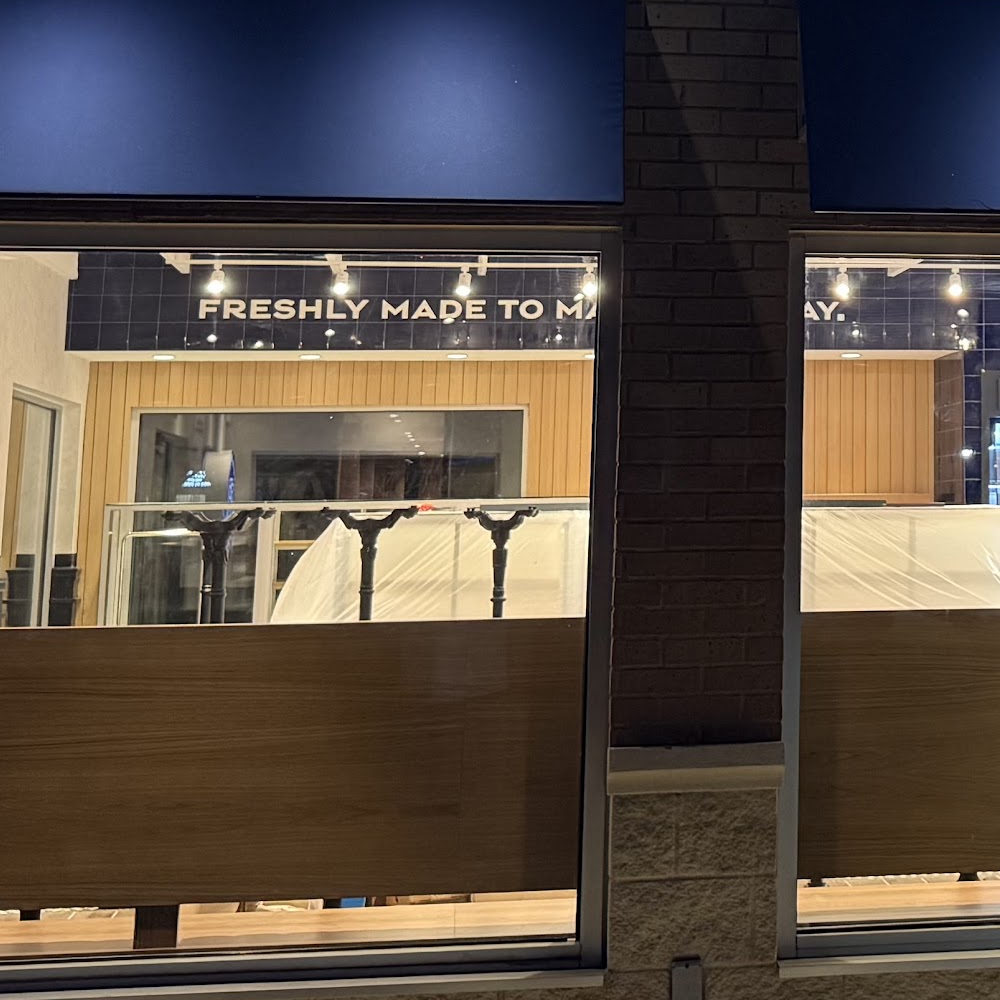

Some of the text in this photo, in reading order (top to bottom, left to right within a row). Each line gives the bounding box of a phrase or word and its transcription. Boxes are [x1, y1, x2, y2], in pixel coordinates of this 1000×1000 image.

[198, 299, 369, 320] FRESHLY
[381, 299, 486, 320] MADE
[498, 299, 544, 320] TO
